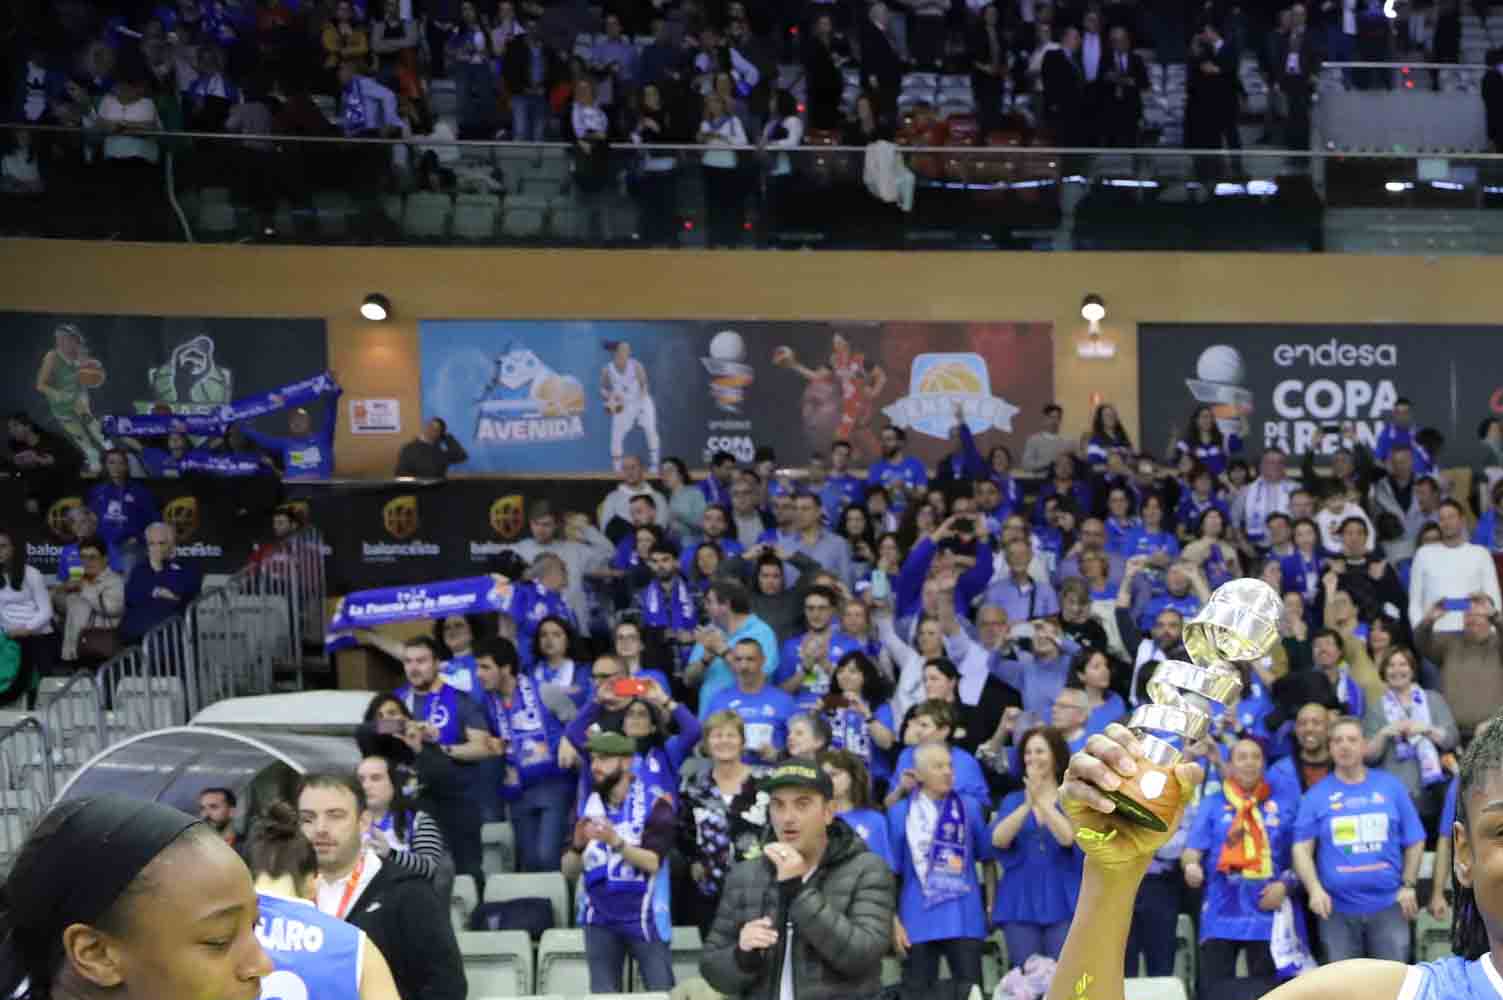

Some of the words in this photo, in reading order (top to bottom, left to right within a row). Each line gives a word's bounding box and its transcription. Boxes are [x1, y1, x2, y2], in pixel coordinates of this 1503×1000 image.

[1273, 338, 1397, 366] endesa
[1273, 380, 1399, 418] COPA
[477, 416, 586, 441] AVENIDA
[1264, 421, 1288, 437] DE
[256, 915, 324, 952] LARO
